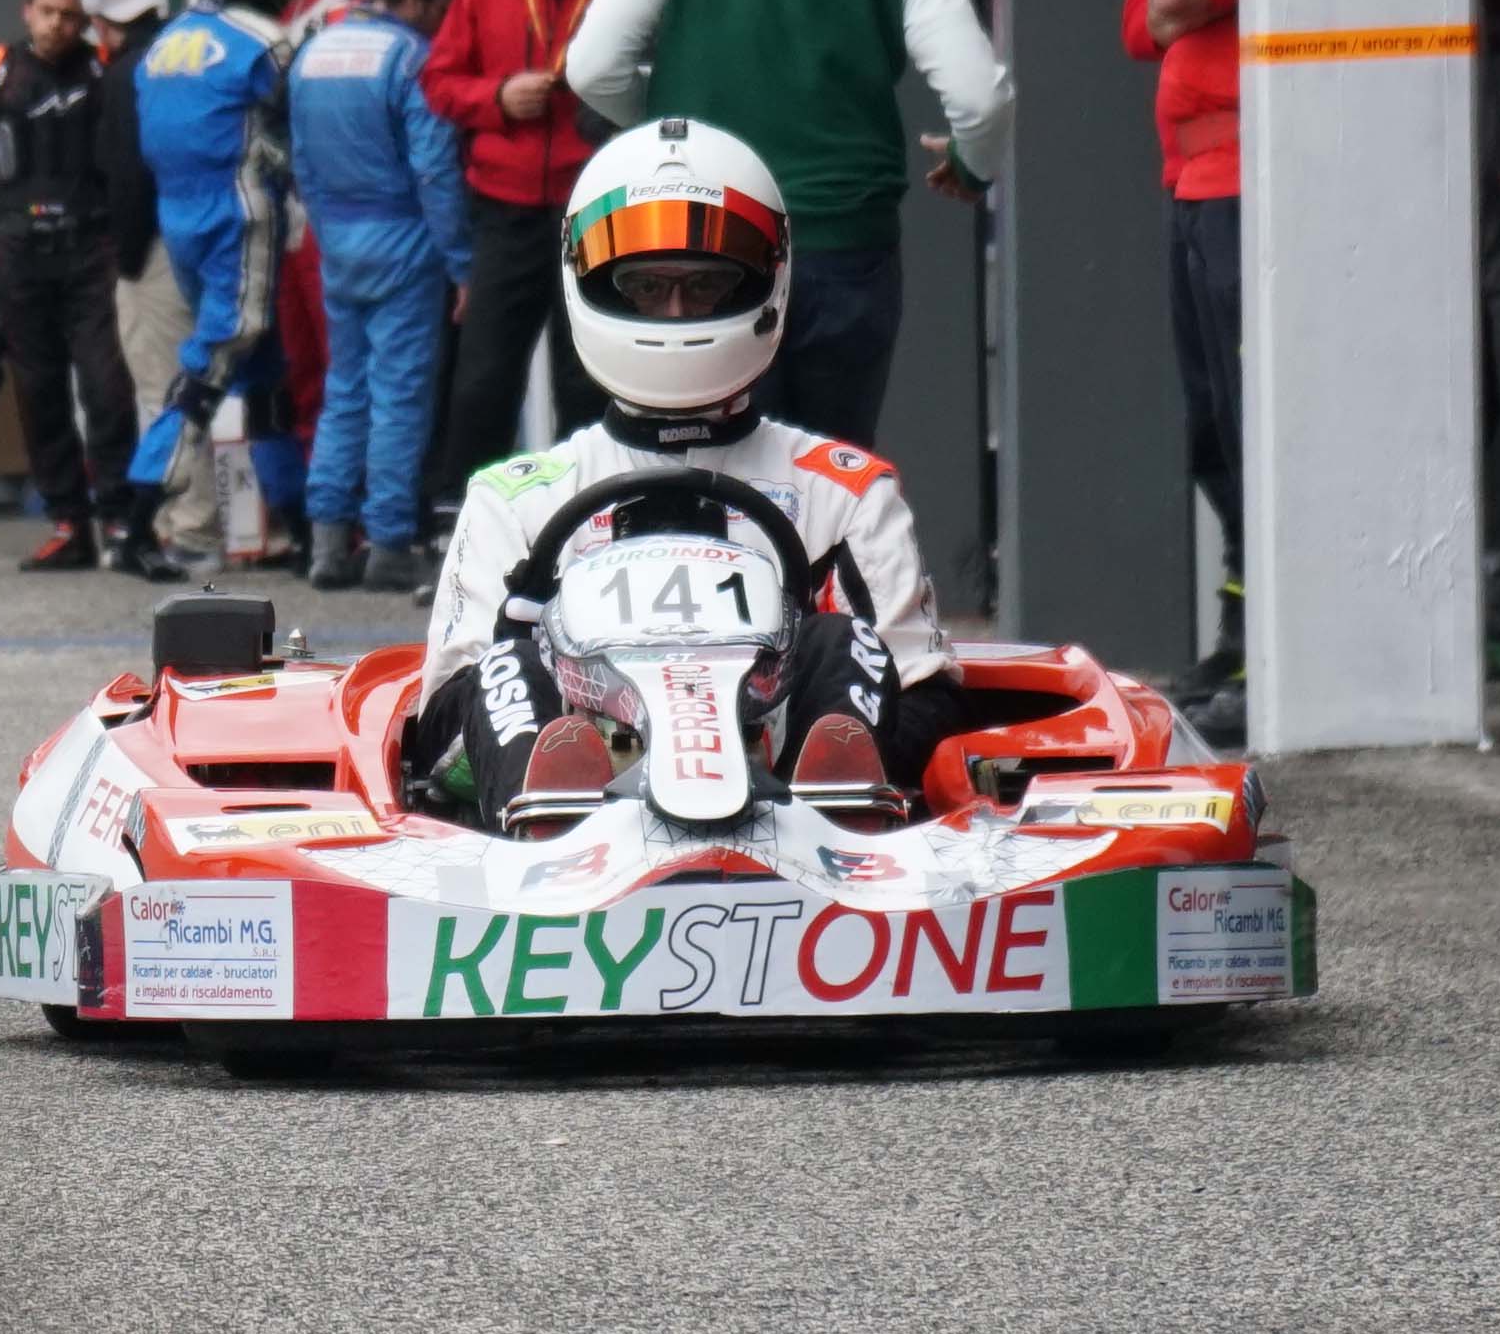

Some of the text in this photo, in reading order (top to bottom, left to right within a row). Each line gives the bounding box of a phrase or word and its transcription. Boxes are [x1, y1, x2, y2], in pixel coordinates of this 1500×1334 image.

[628, 180, 723, 200] keystone
[588, 546, 743, 572] EUROINDY
[661, 662, 724, 782] FERBERTO
[1117, 794, 1218, 821] eni
[267, 814, 367, 841] eni
[130, 895, 169, 922] Calor
[1167, 886, 1216, 912] Calor
[168, 918, 277, 945] Ricambi M.G.
[1213, 908, 1264, 934] Ricambi
[423, 890, 1056, 1017] KEYSTONE
[164, 966, 179, 980] per
[223, 964, 278, 979] bruciatori
[142, 985, 177, 1001] impianti
[180, 985, 189, 998] di
[192, 985, 274, 999] riscaldamento
